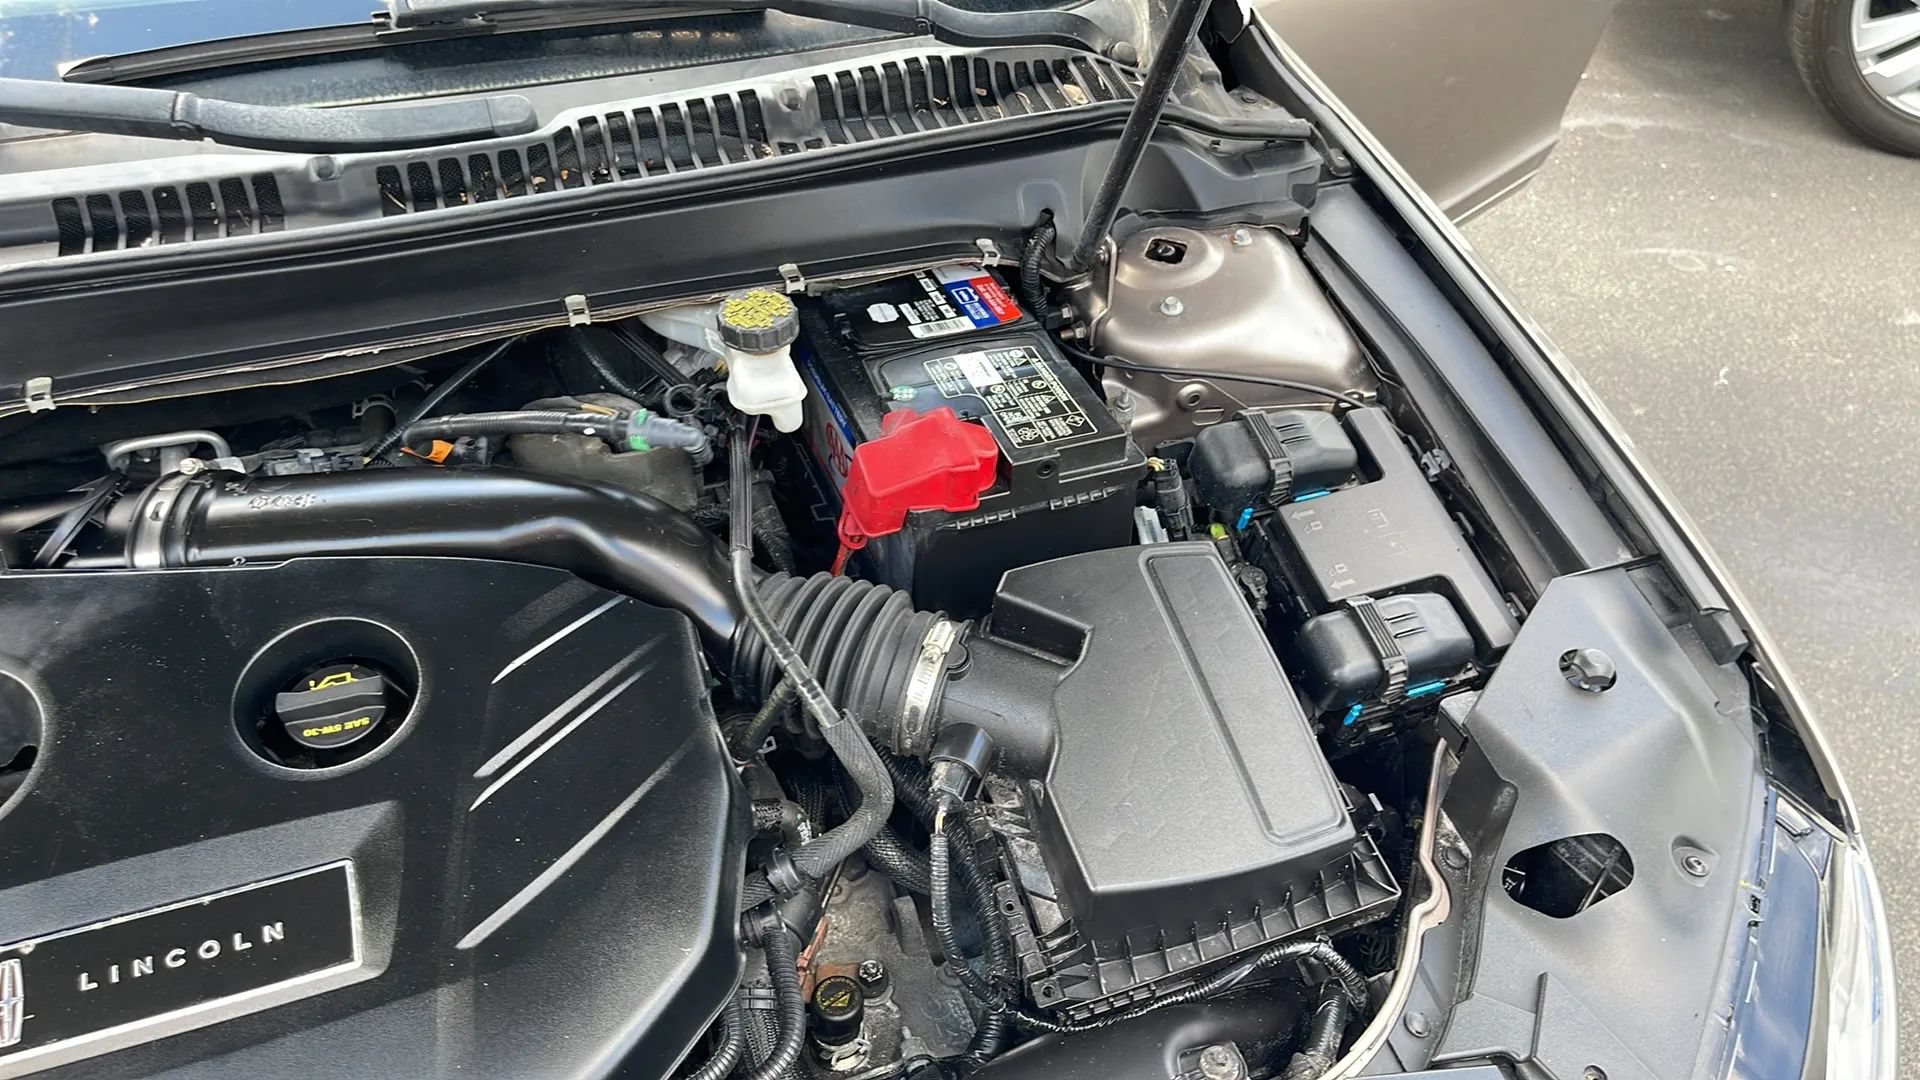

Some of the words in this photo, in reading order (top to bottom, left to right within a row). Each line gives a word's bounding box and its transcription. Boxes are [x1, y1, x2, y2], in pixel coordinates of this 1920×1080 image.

[303, 723, 342, 737] 5W-30
[343, 716, 370, 730] SAE
[78, 920, 285, 992] LINCOLN
